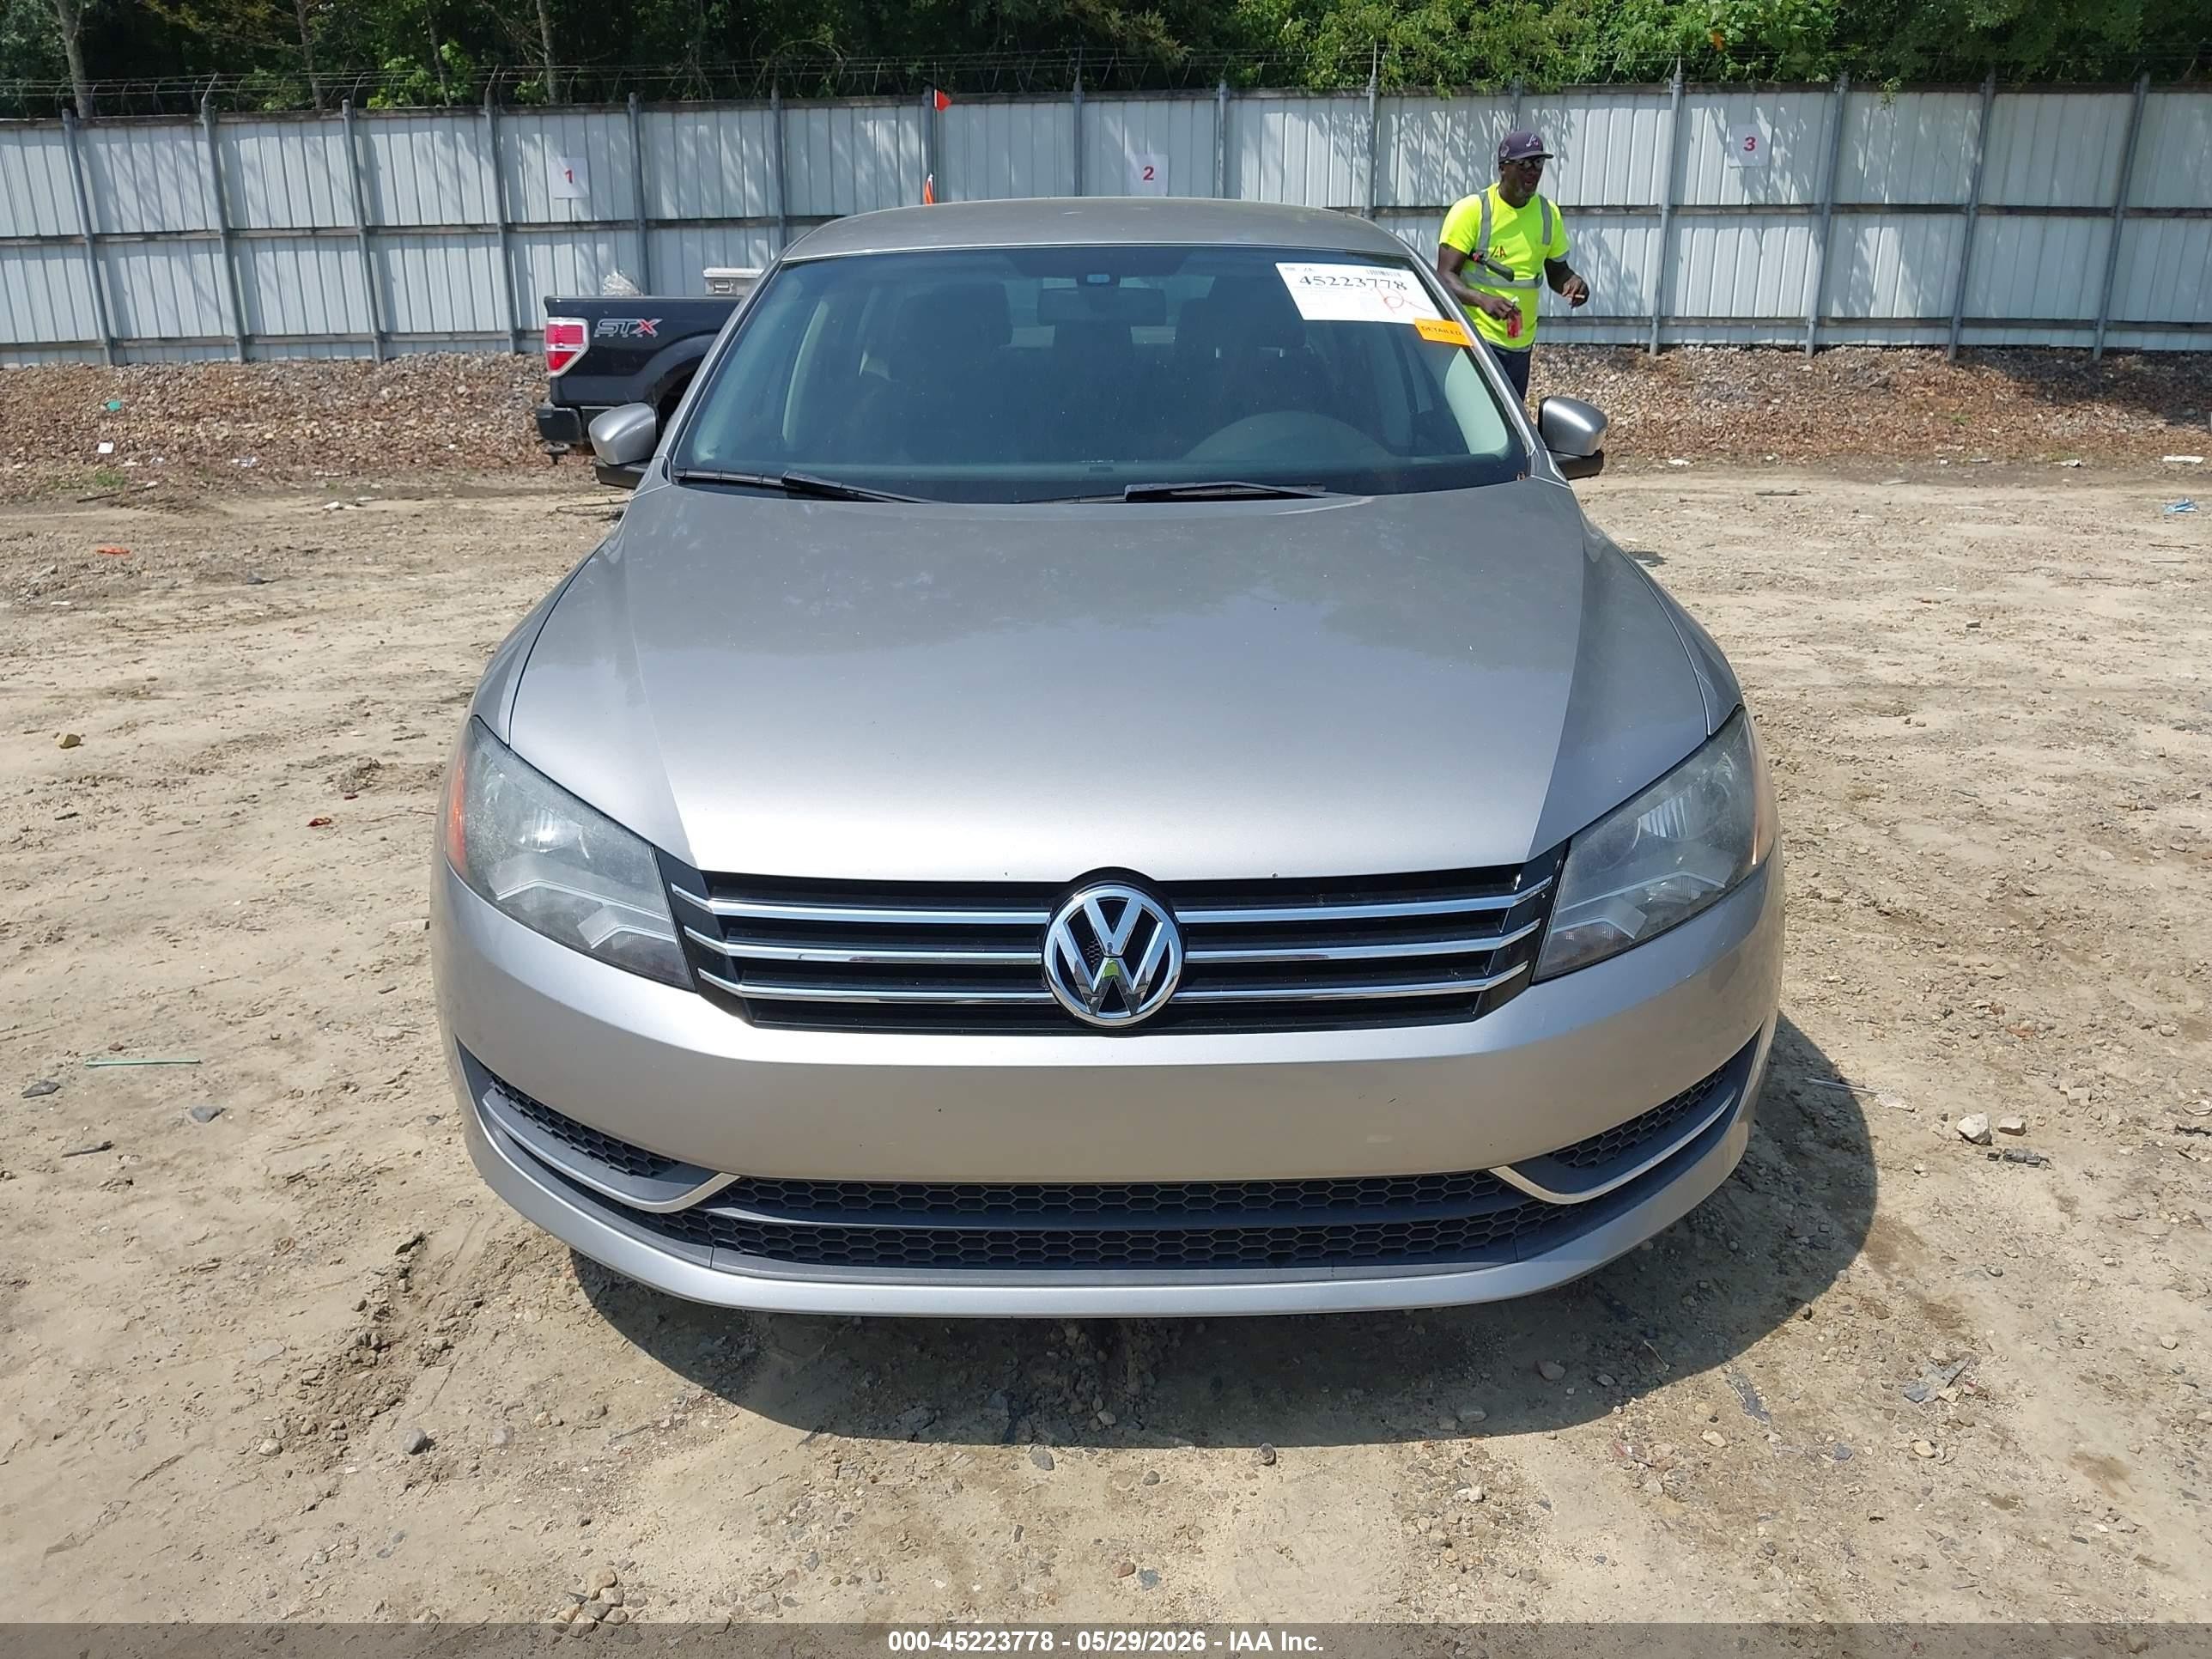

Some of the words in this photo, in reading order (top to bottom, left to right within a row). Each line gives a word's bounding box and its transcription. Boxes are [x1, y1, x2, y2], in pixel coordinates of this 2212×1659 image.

[1743, 136, 1756, 152] 3
[565, 169, 573, 184] 1
[1143, 166, 1154, 181] 2
[1299, 276, 1407, 291] 45223778
[594, 318, 663, 336] STX
[1044, 884, 1182, 1028] VW
